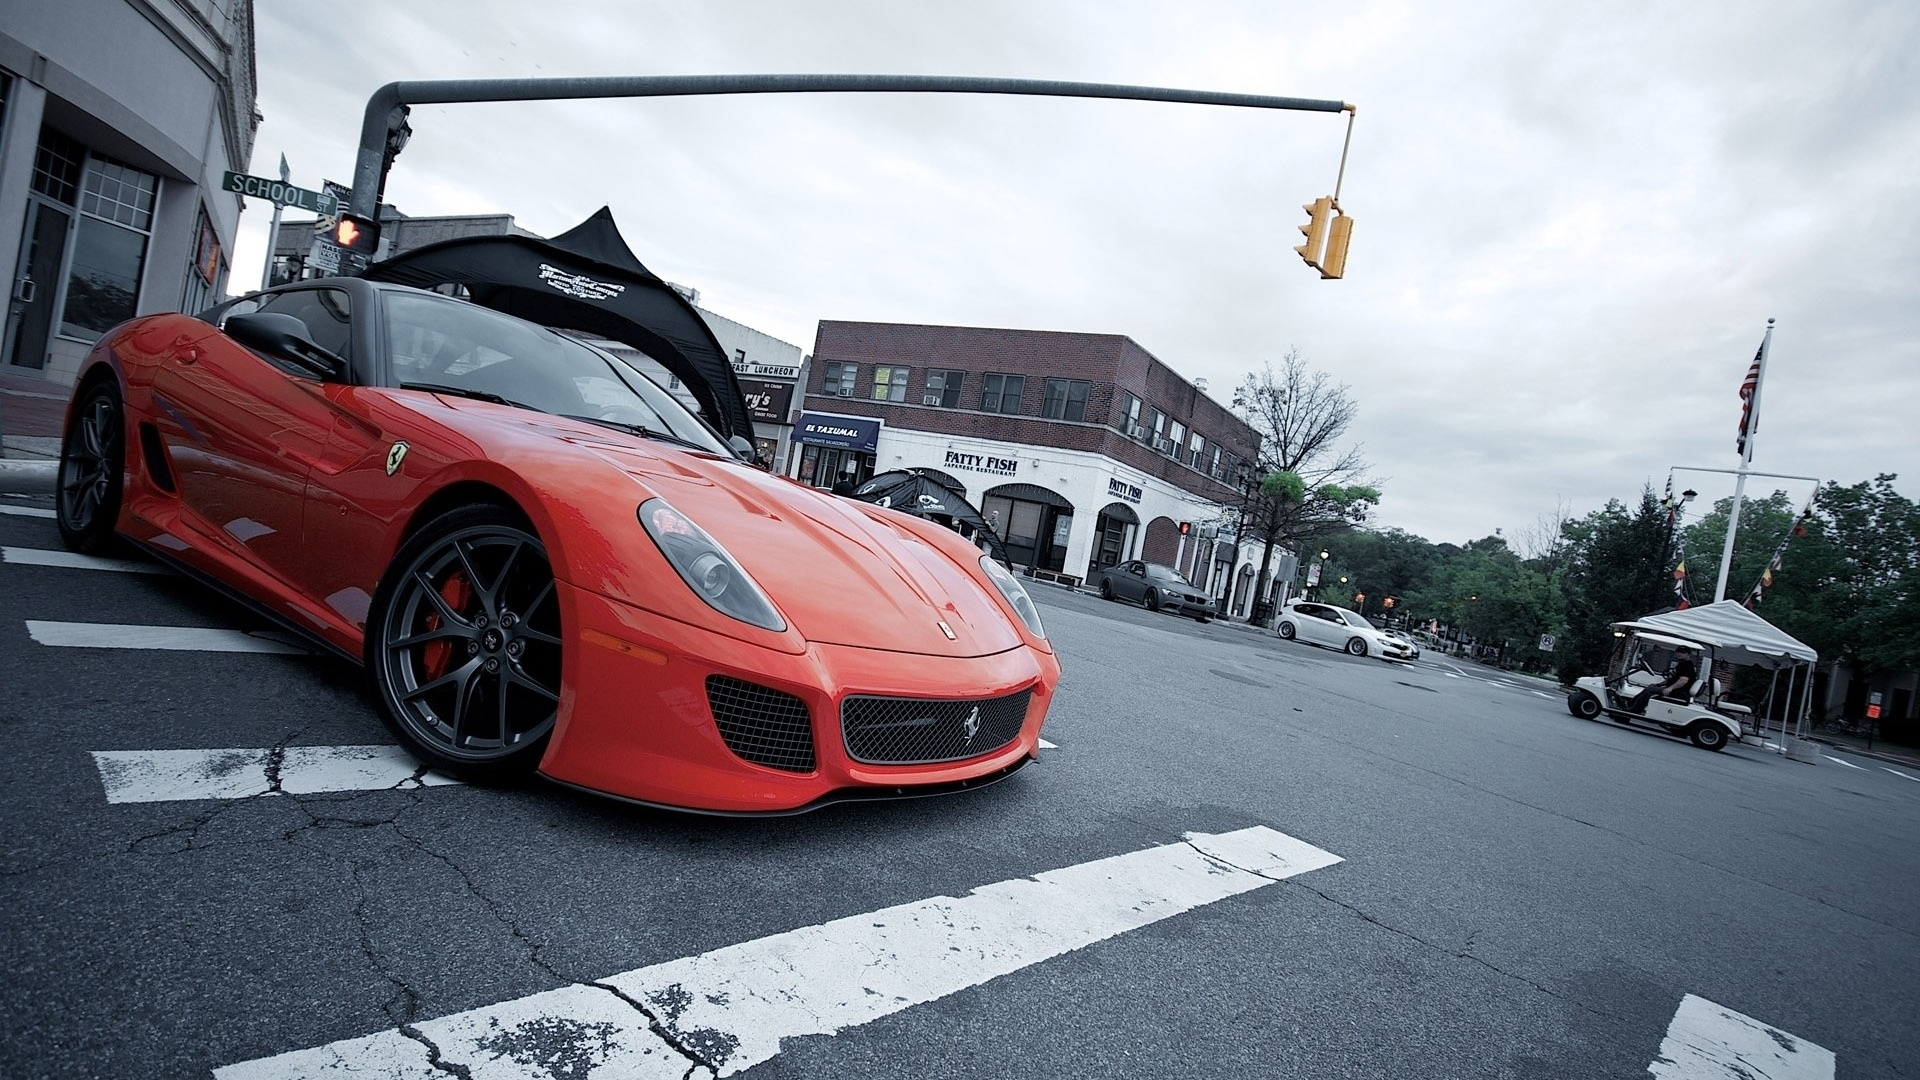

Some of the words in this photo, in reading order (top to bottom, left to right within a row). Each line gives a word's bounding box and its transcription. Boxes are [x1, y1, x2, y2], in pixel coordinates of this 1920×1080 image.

[231, 174, 308, 208] SCHOOL
[316, 203, 328, 213] ST
[732, 364, 749, 373] FAST
[754, 365, 794, 376] LUNCHEON
[744, 391, 771, 409] ry's
[805, 424, 816, 432] EL
[816, 425, 859, 437] TAZUMAL
[943, 462, 974, 471] JAPANESE
[976, 467, 1016, 478] RESTAURANT
[945, 451, 984, 467] FATTY
[986, 456, 1018, 472] FISH
[1109, 477, 1128, 494] FATTY
[1128, 484, 1143, 500] FISH
